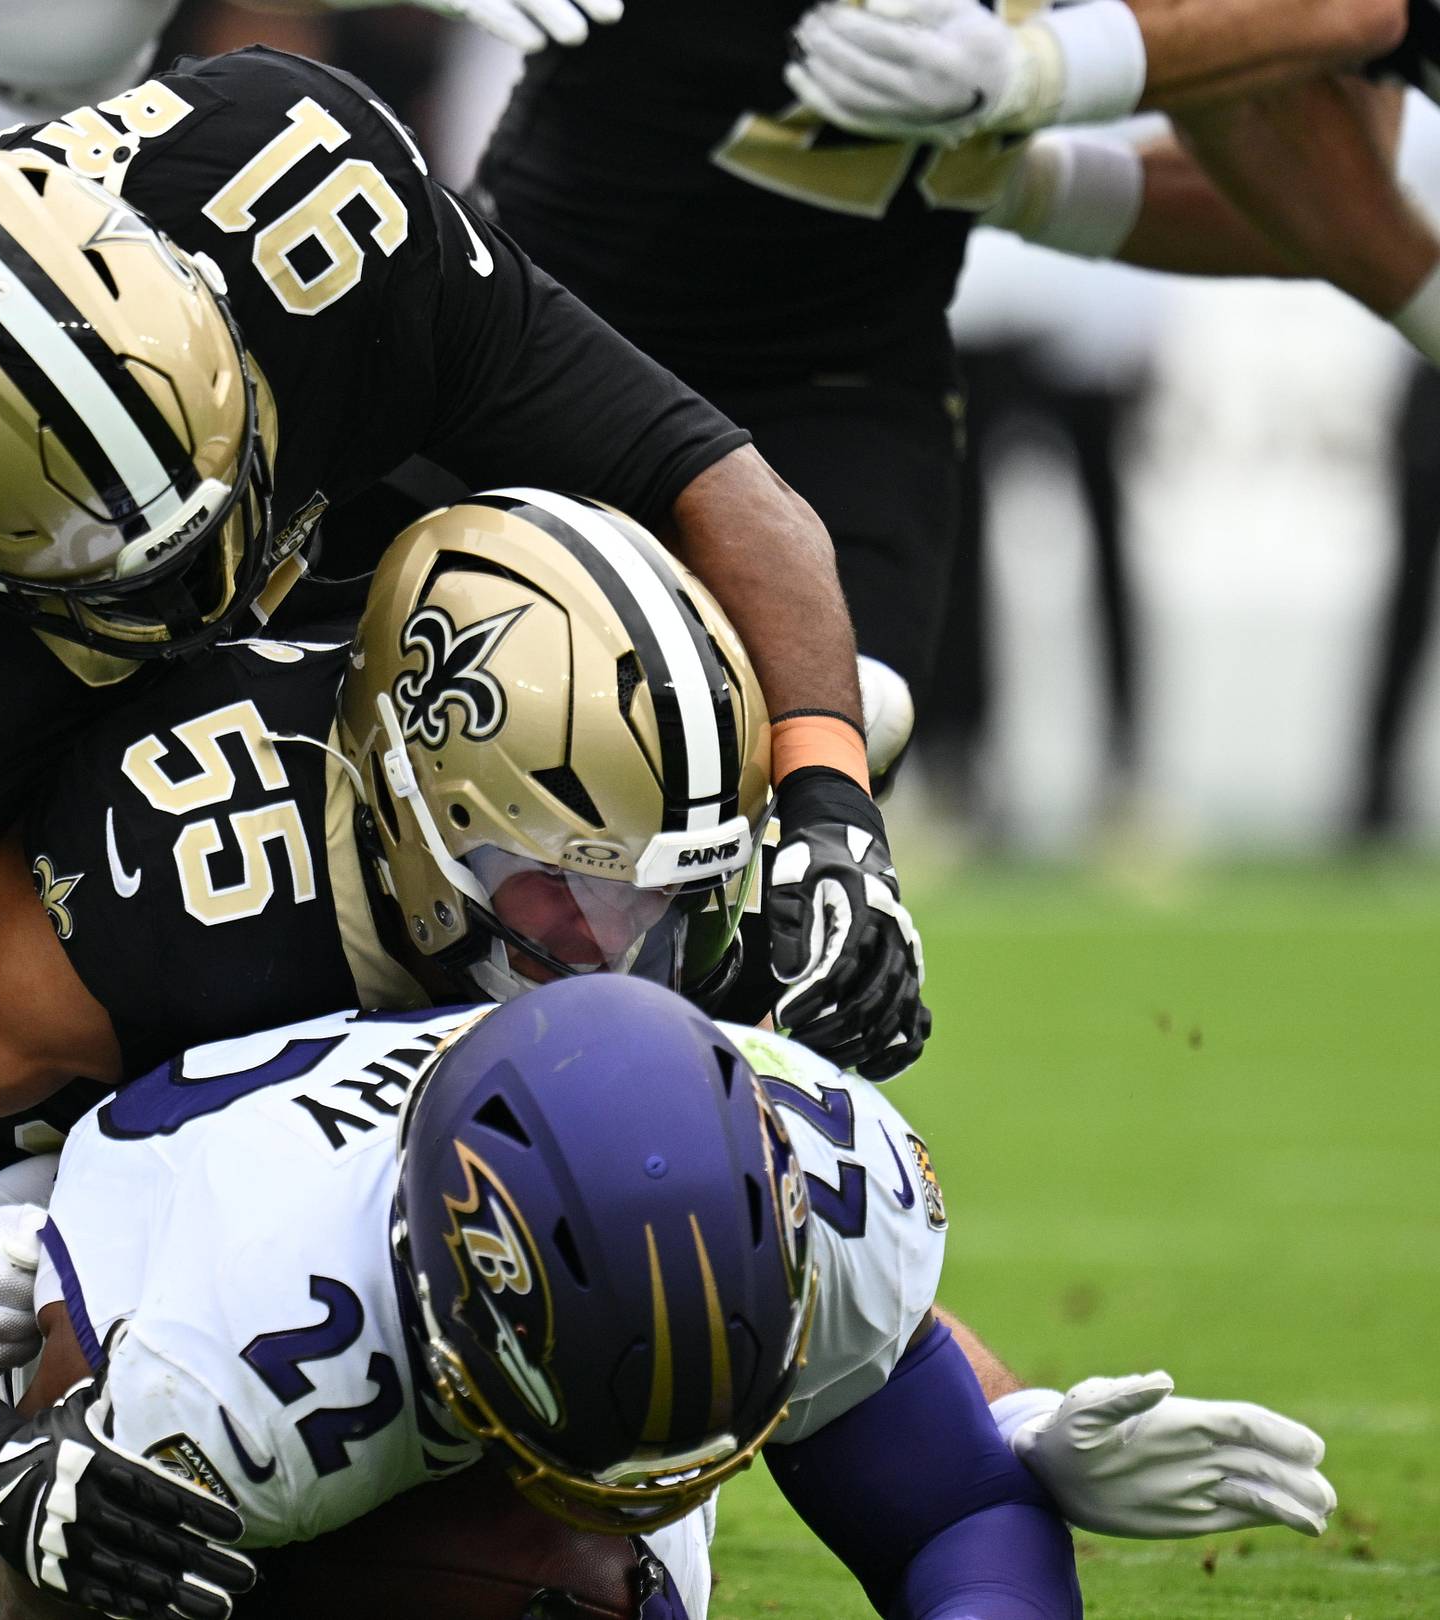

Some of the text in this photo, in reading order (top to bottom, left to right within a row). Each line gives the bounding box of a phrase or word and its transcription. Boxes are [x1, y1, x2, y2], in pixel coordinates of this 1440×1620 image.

[201, 96, 409, 316] 91
[120, 700, 316, 926] 55
[562, 852, 629, 872] OAKLEY
[677, 839, 740, 868] SAINTS
[241, 1274, 404, 1478] 22
